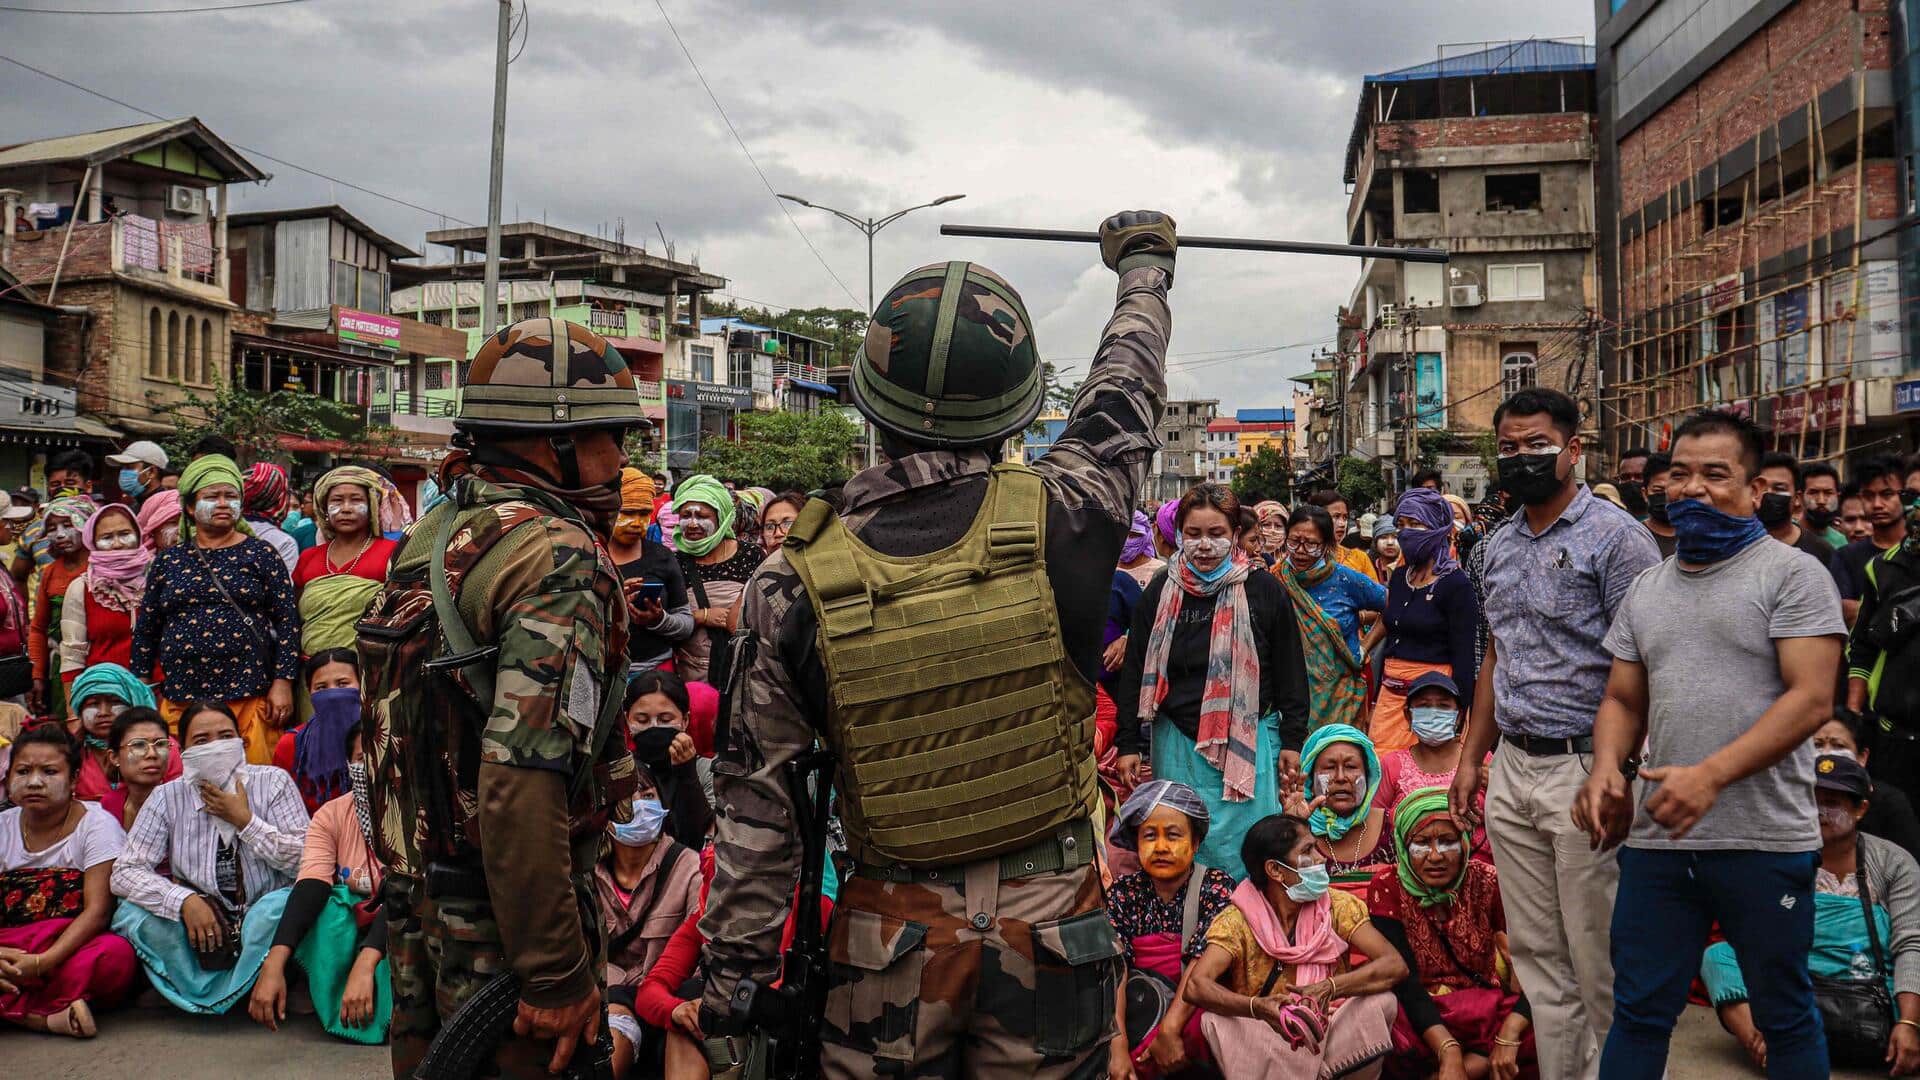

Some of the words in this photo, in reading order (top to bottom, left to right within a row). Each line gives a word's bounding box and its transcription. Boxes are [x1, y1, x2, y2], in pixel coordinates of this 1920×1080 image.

[340, 317, 355, 329] CAKE
[356, 320, 384, 335] MATERIALS
[384, 325, 399, 338] SHOP
